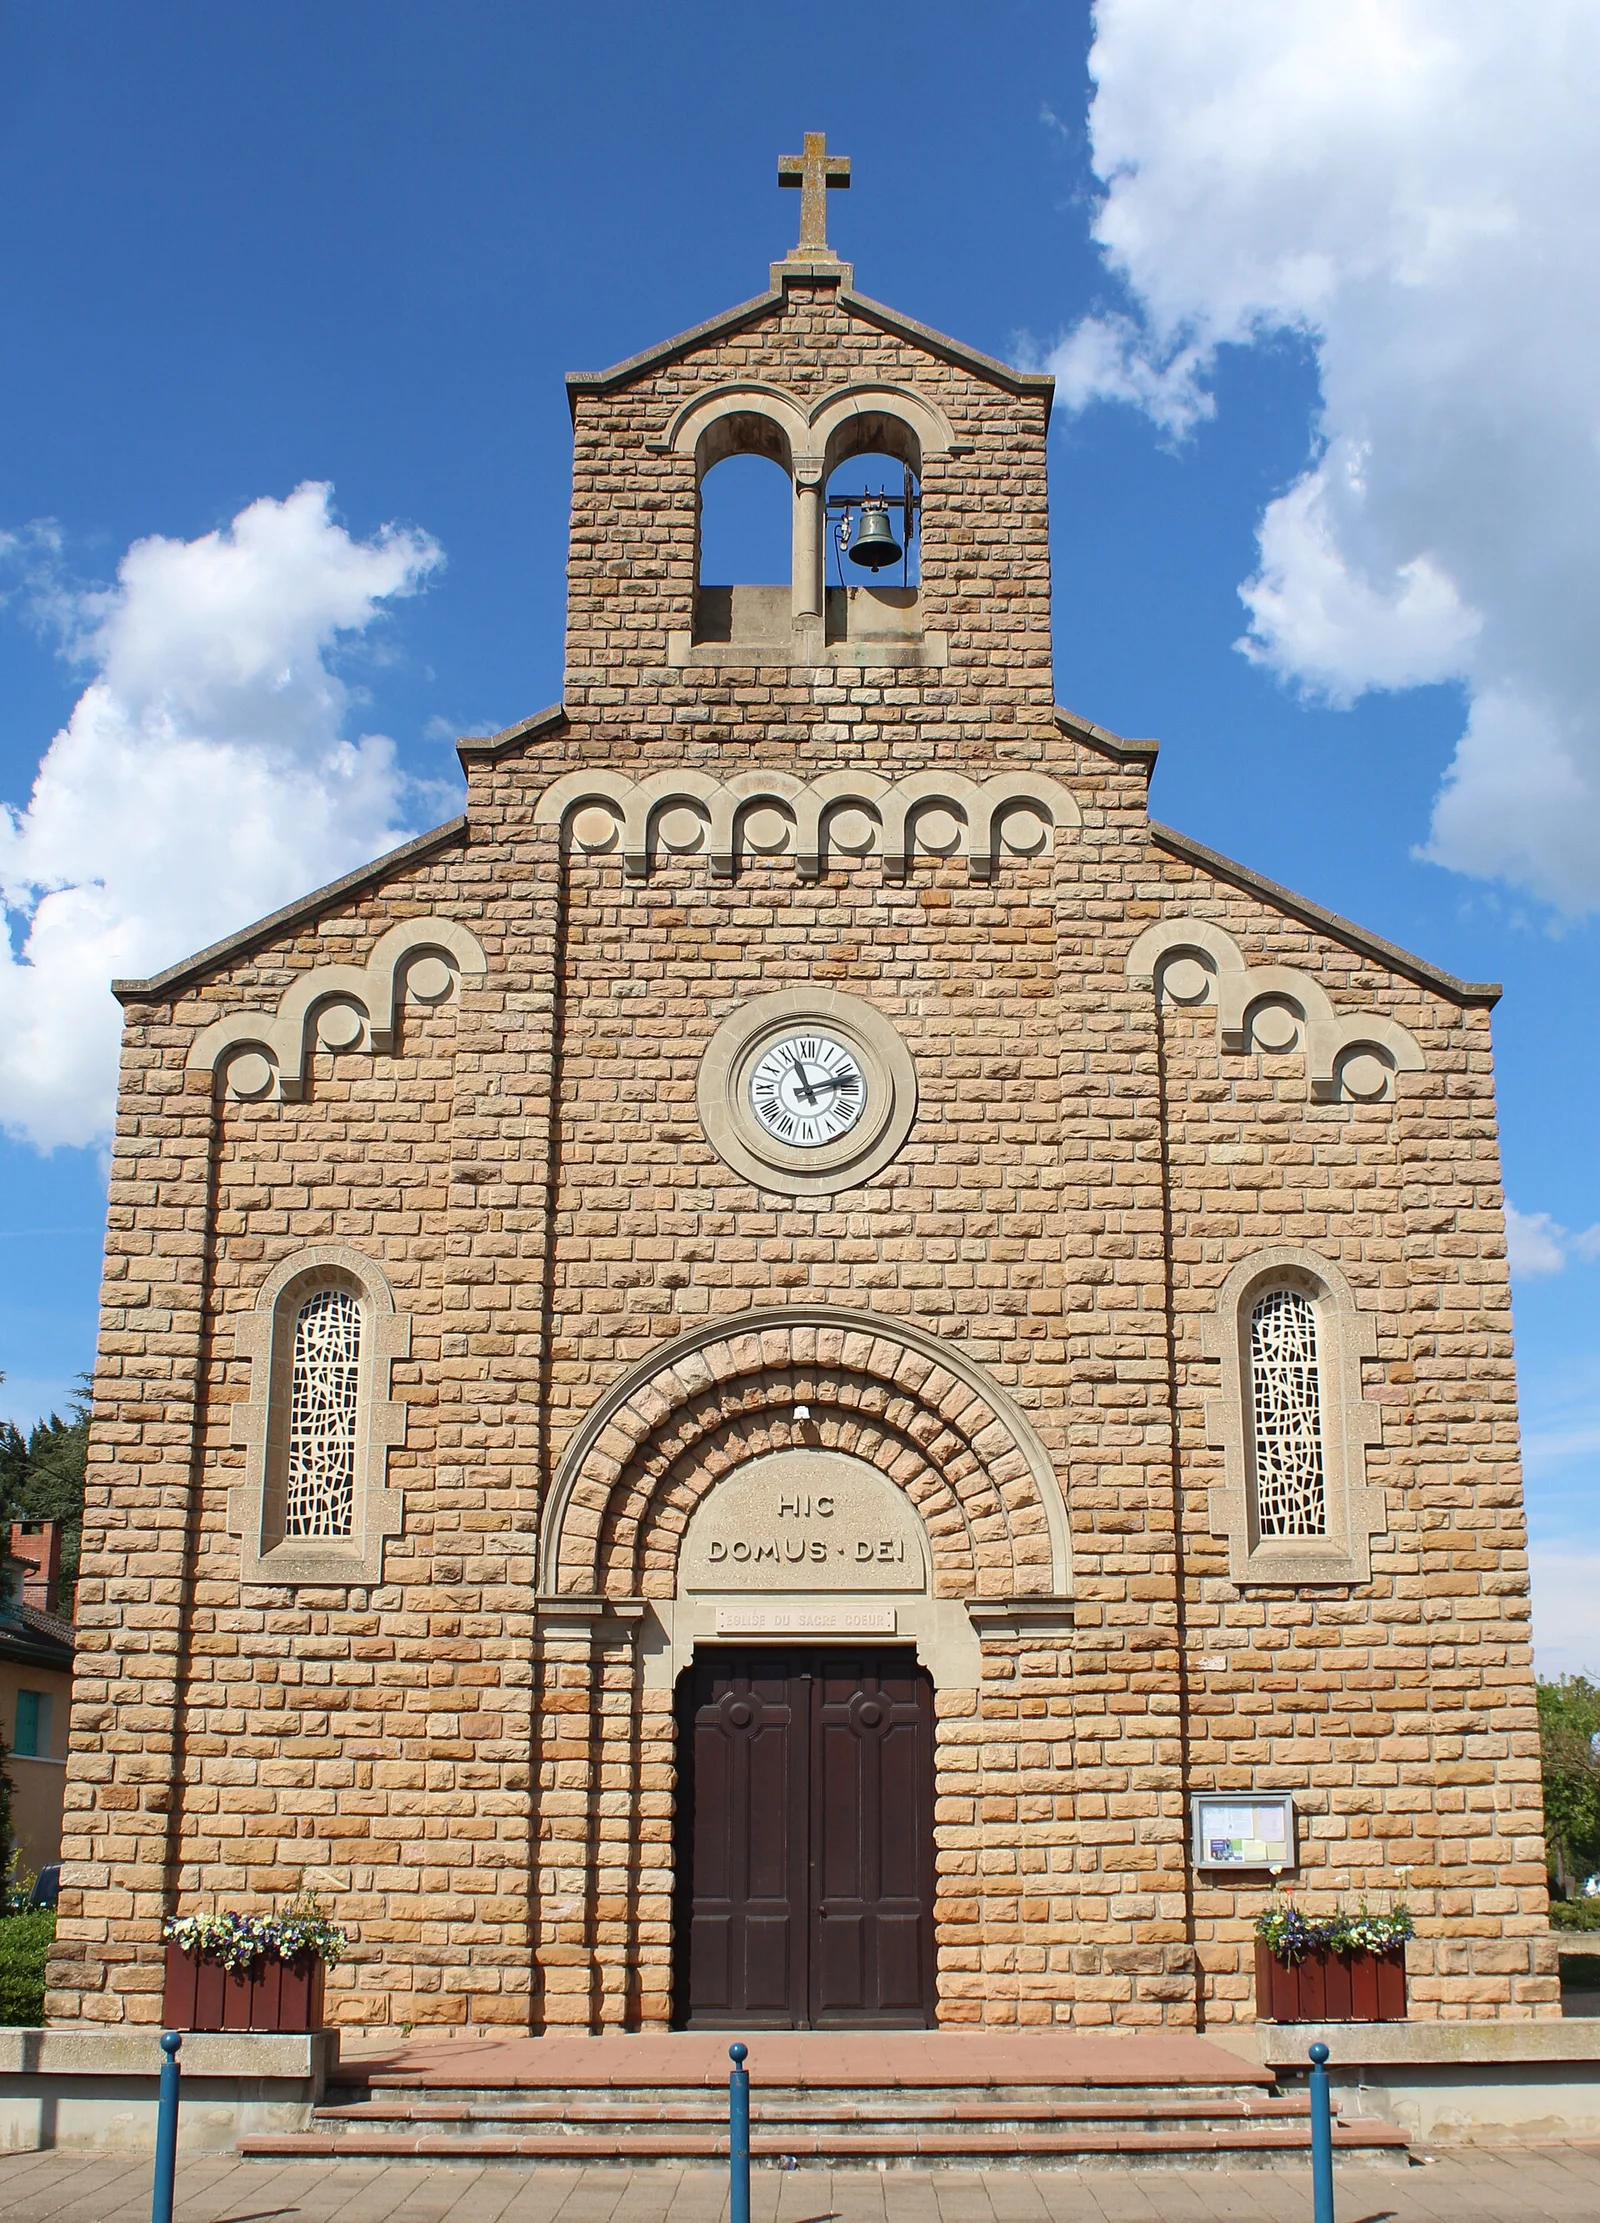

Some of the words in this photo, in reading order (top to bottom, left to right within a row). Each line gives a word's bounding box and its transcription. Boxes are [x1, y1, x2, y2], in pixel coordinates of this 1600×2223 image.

[778, 1045, 796, 1065] XI
[800, 1041, 815, 1058] XII
[824, 1047, 834, 1062] I
[762, 1063, 780, 1076] X
[836, 1063, 853, 1076] II
[756, 1084, 774, 1095] IX
[834, 1100, 855, 1120] IIII
[777, 1115, 794, 1136] VII
[803, 1122, 813, 1139] VI
[825, 1119, 836, 1134] V
[778, 1494, 834, 1517] HIC
[708, 1538, 826, 1562] DOMUS
[855, 1539, 904, 1562] DEI
[774, 1614, 791, 1626] DU
[846, 1614, 884, 1626] COEUR
